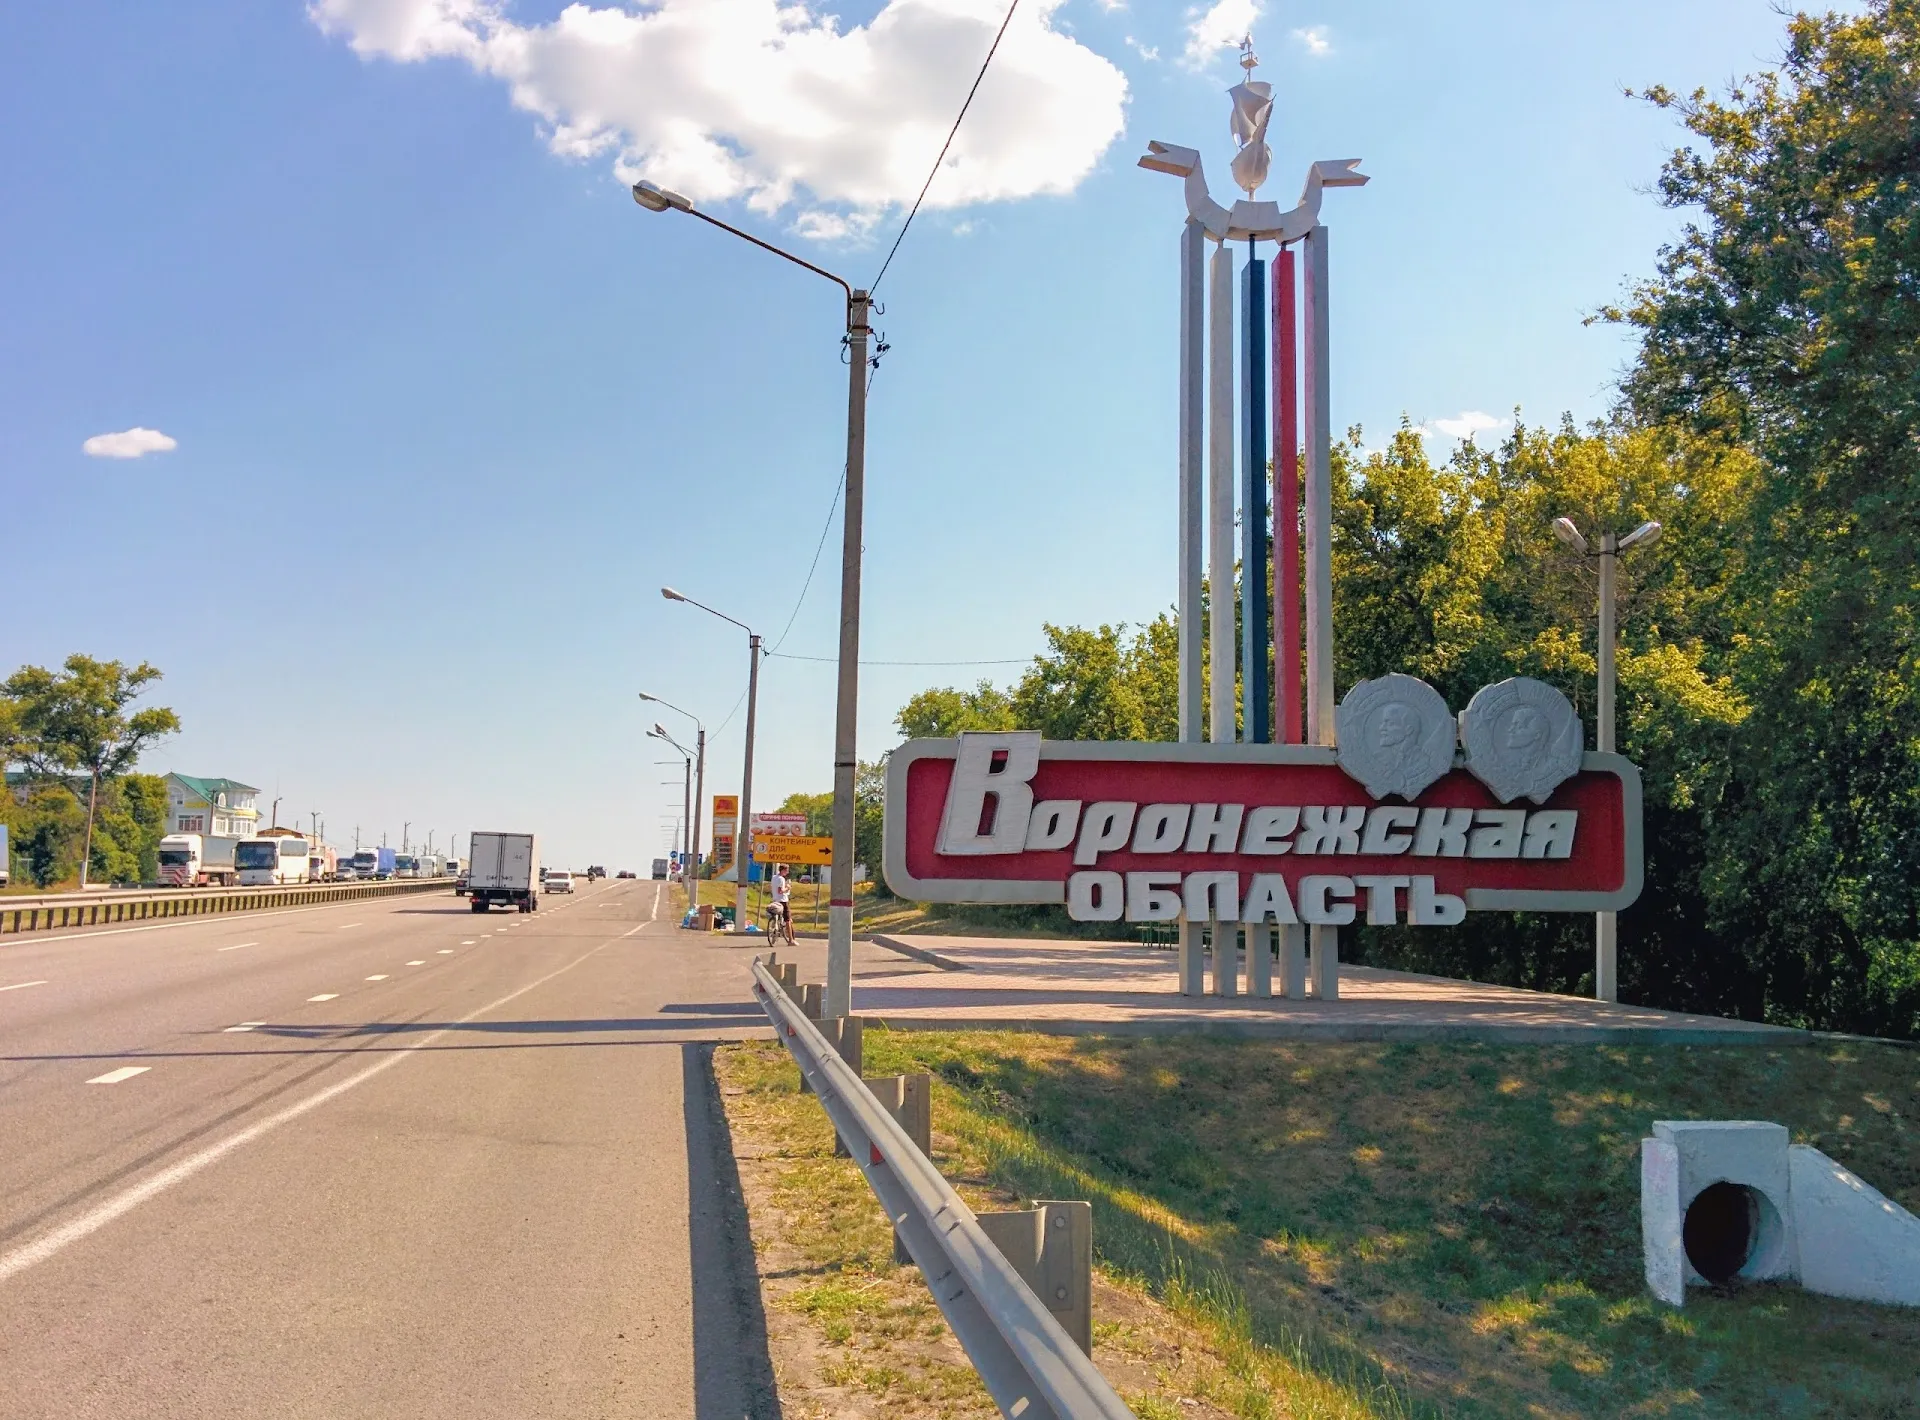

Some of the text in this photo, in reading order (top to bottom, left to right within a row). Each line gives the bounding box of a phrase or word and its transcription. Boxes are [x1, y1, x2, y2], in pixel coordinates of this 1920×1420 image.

[935, 731, 1578, 865] Воронежская
[769, 845, 786, 853] ДЛЯ
[1067, 870, 1467, 926] ОБЛАСТЬ
